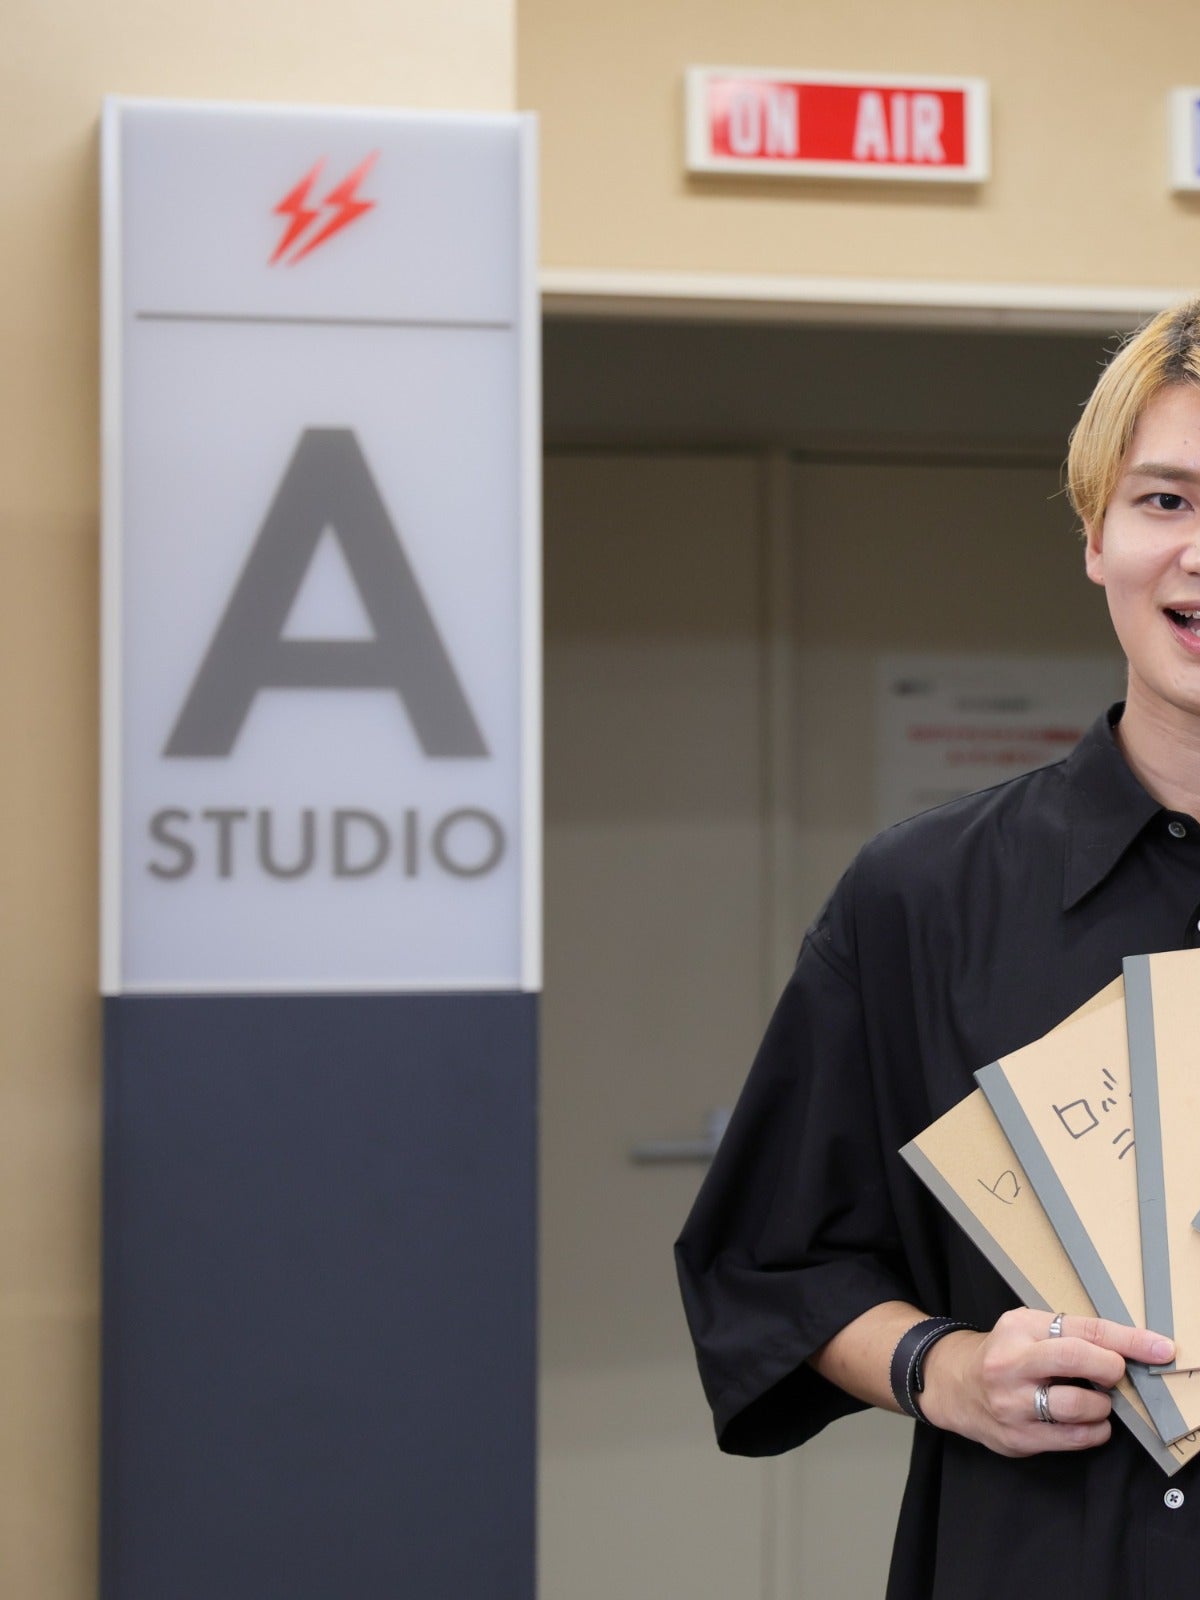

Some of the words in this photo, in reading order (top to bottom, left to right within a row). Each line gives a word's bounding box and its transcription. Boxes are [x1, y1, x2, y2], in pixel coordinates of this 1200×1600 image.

[727, 87, 799, 158] ON
[851, 91, 946, 163] AIR
[160, 425, 492, 759] A
[145, 807, 507, 881] STUDIO
